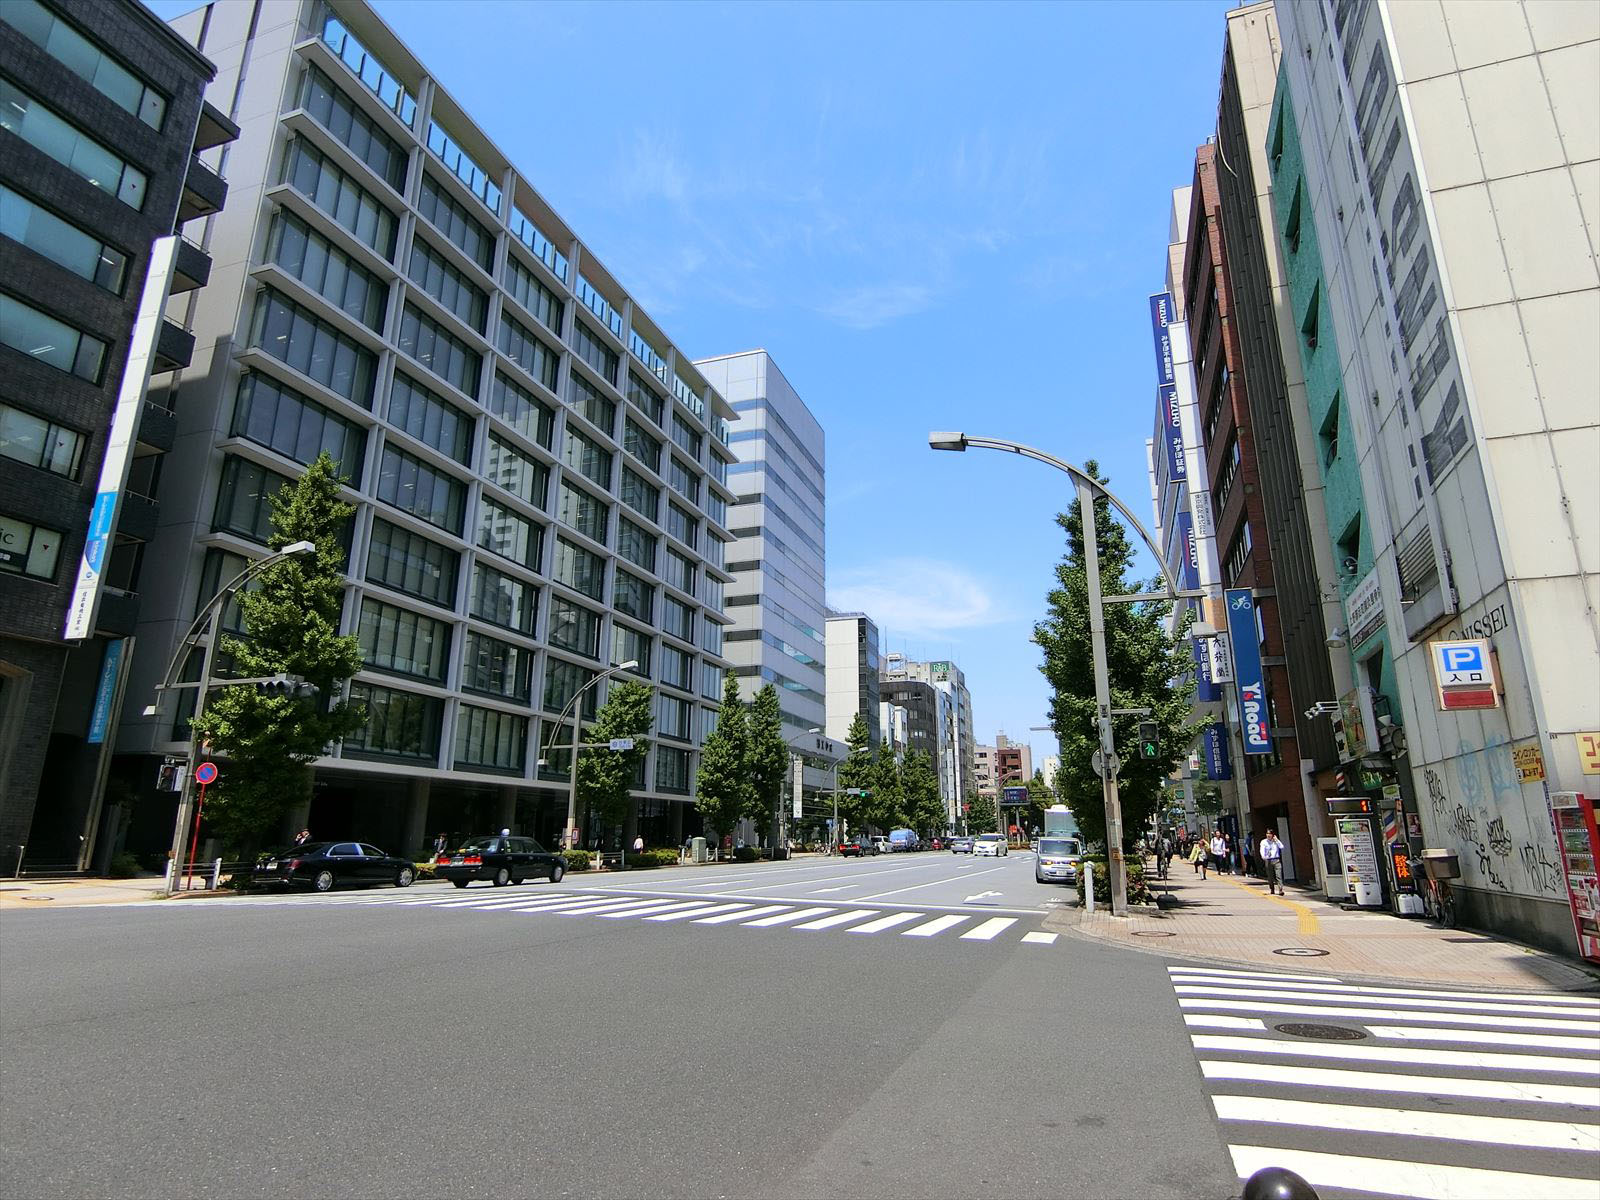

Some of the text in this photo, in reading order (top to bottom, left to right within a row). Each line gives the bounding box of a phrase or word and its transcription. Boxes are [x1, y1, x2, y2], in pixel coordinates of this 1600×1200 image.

[1158, 299, 1168, 328] MIZUHO
[1169, 391, 1180, 427] MIZUHO
[1447, 649, 1476, 670] P
[1450, 672, 1482, 682] 入口
